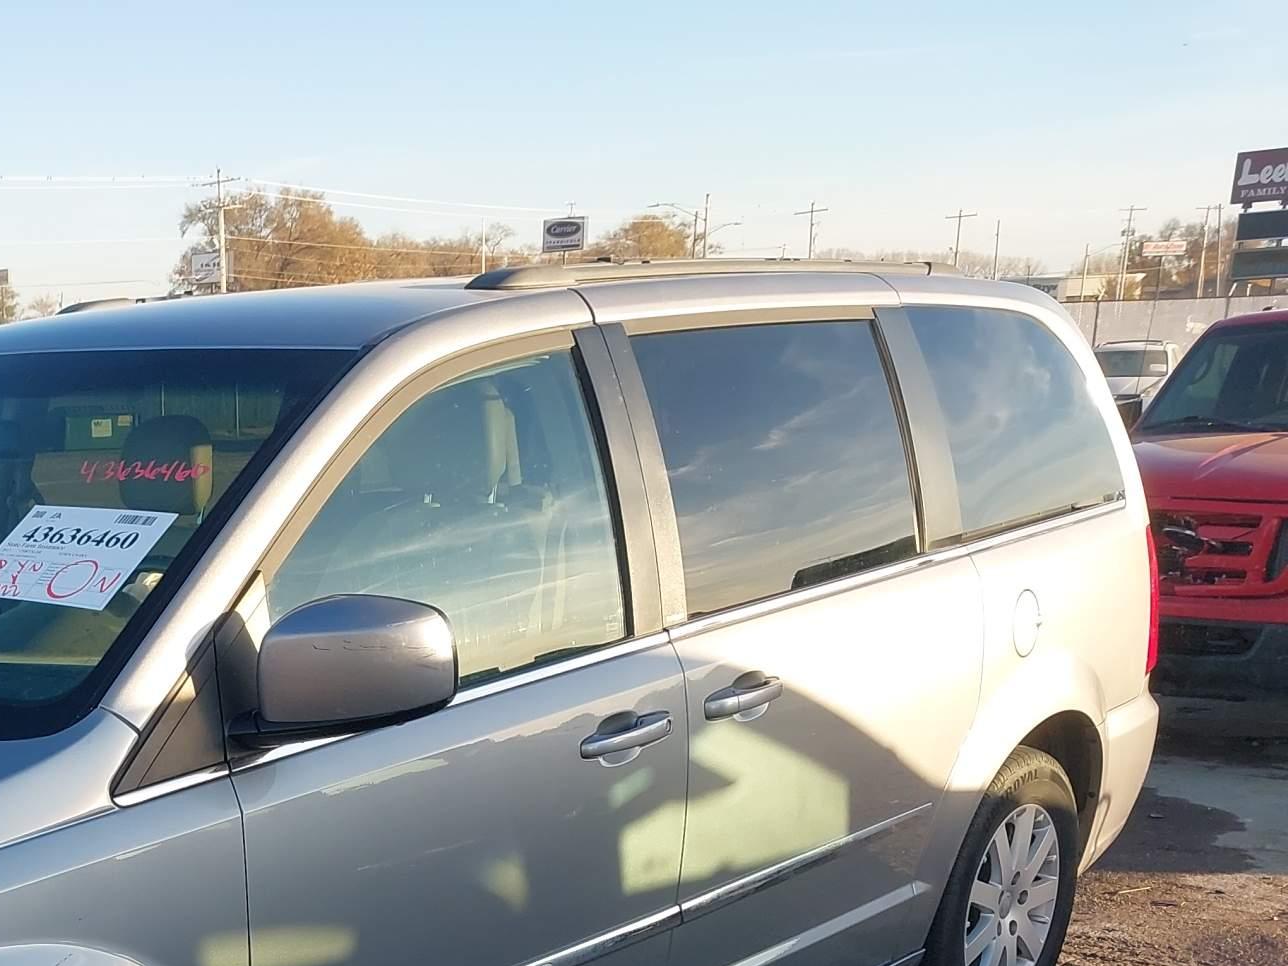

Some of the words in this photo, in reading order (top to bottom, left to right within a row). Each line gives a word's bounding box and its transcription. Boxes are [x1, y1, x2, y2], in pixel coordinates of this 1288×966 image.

[1240, 186, 1287, 198] FAMILY
[551, 225, 577, 233] Carrier
[81, 460, 210, 483] 43636460
[23, 526, 140, 550] 43636460
